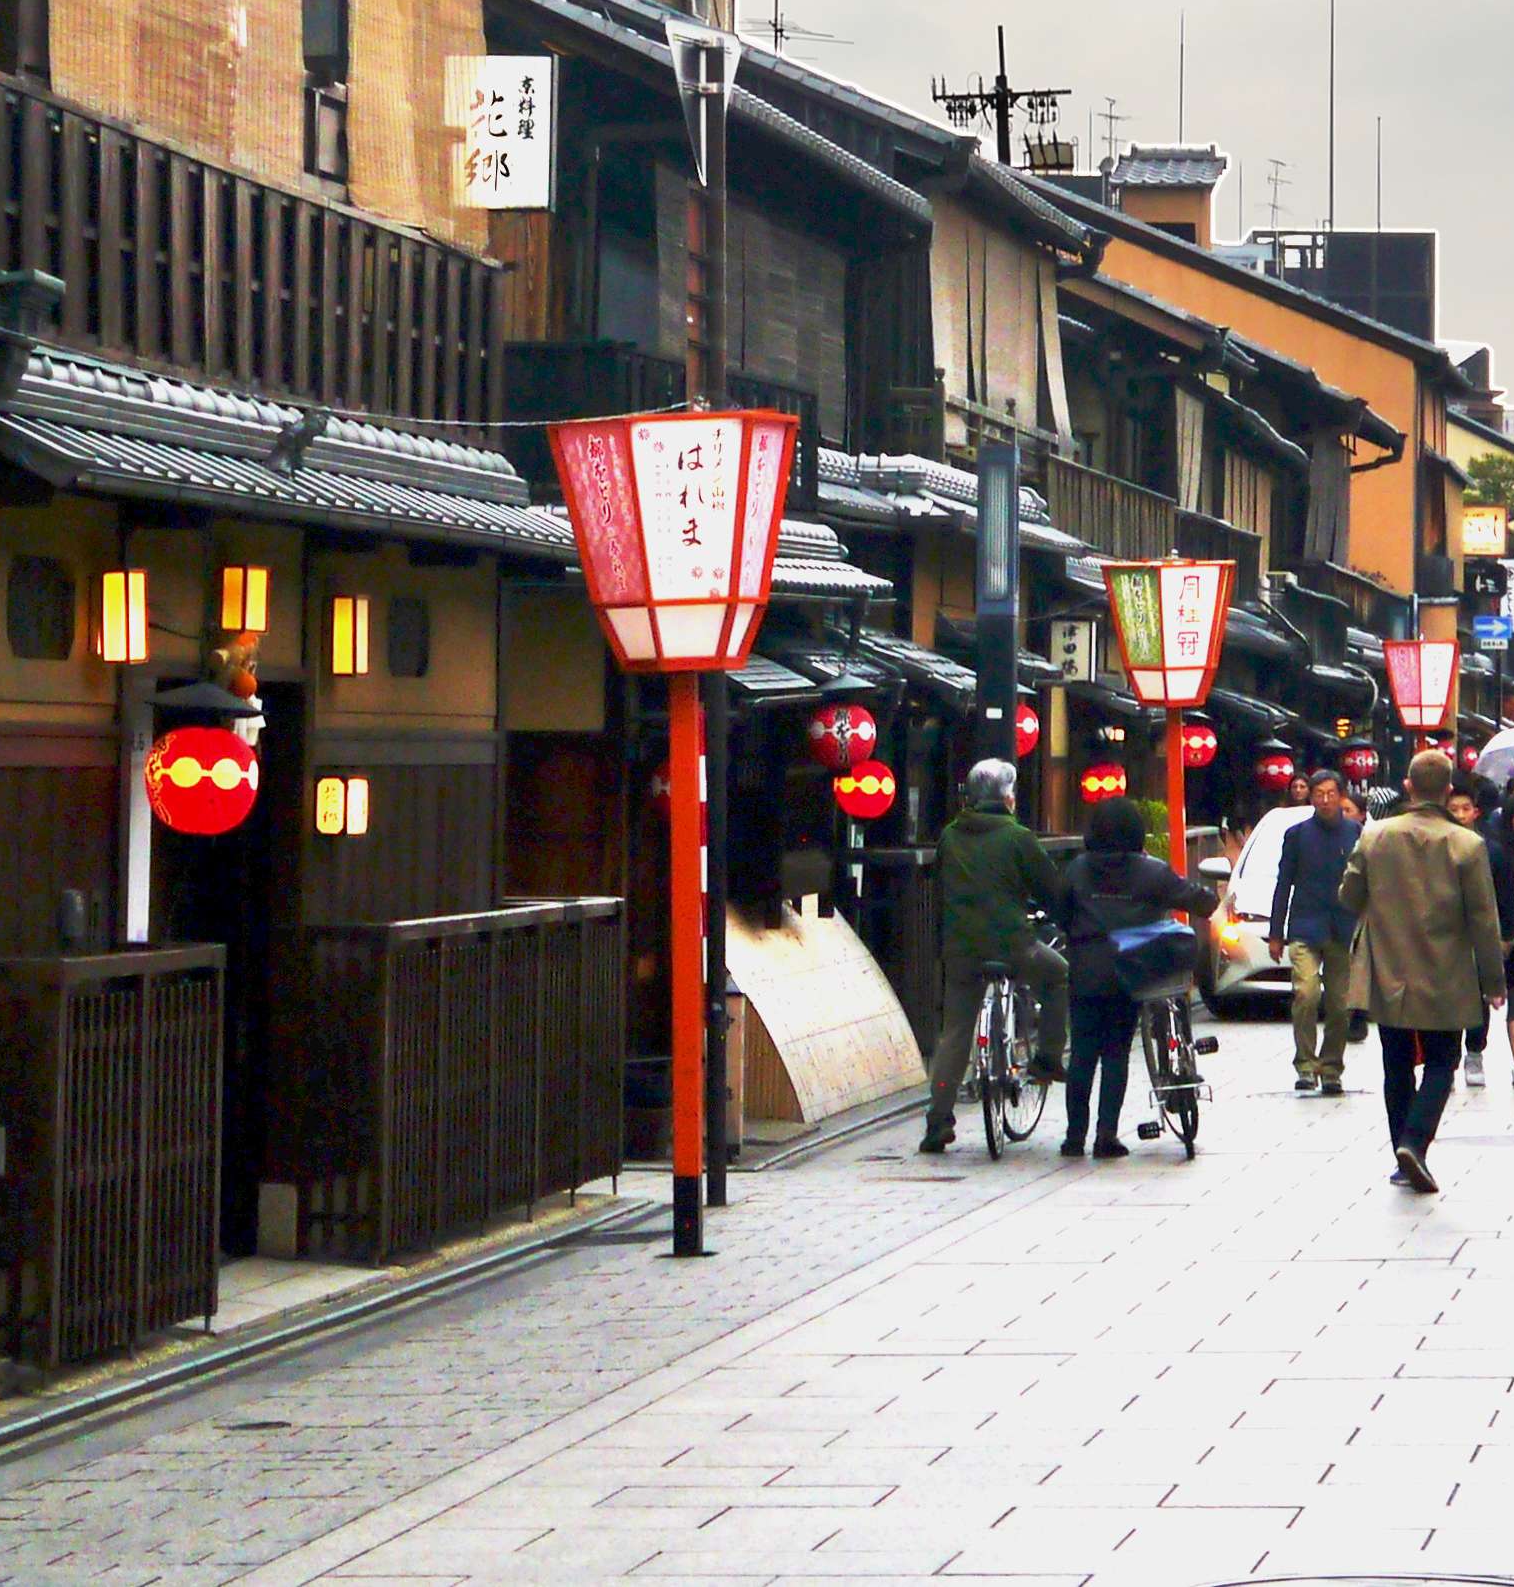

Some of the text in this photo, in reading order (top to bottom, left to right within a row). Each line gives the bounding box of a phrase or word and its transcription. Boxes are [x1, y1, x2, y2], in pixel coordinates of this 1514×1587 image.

[517, 74, 537, 141] 京料理
[677, 443, 705, 547] はれま
[1177, 575, 1201, 656] 月桂冠
